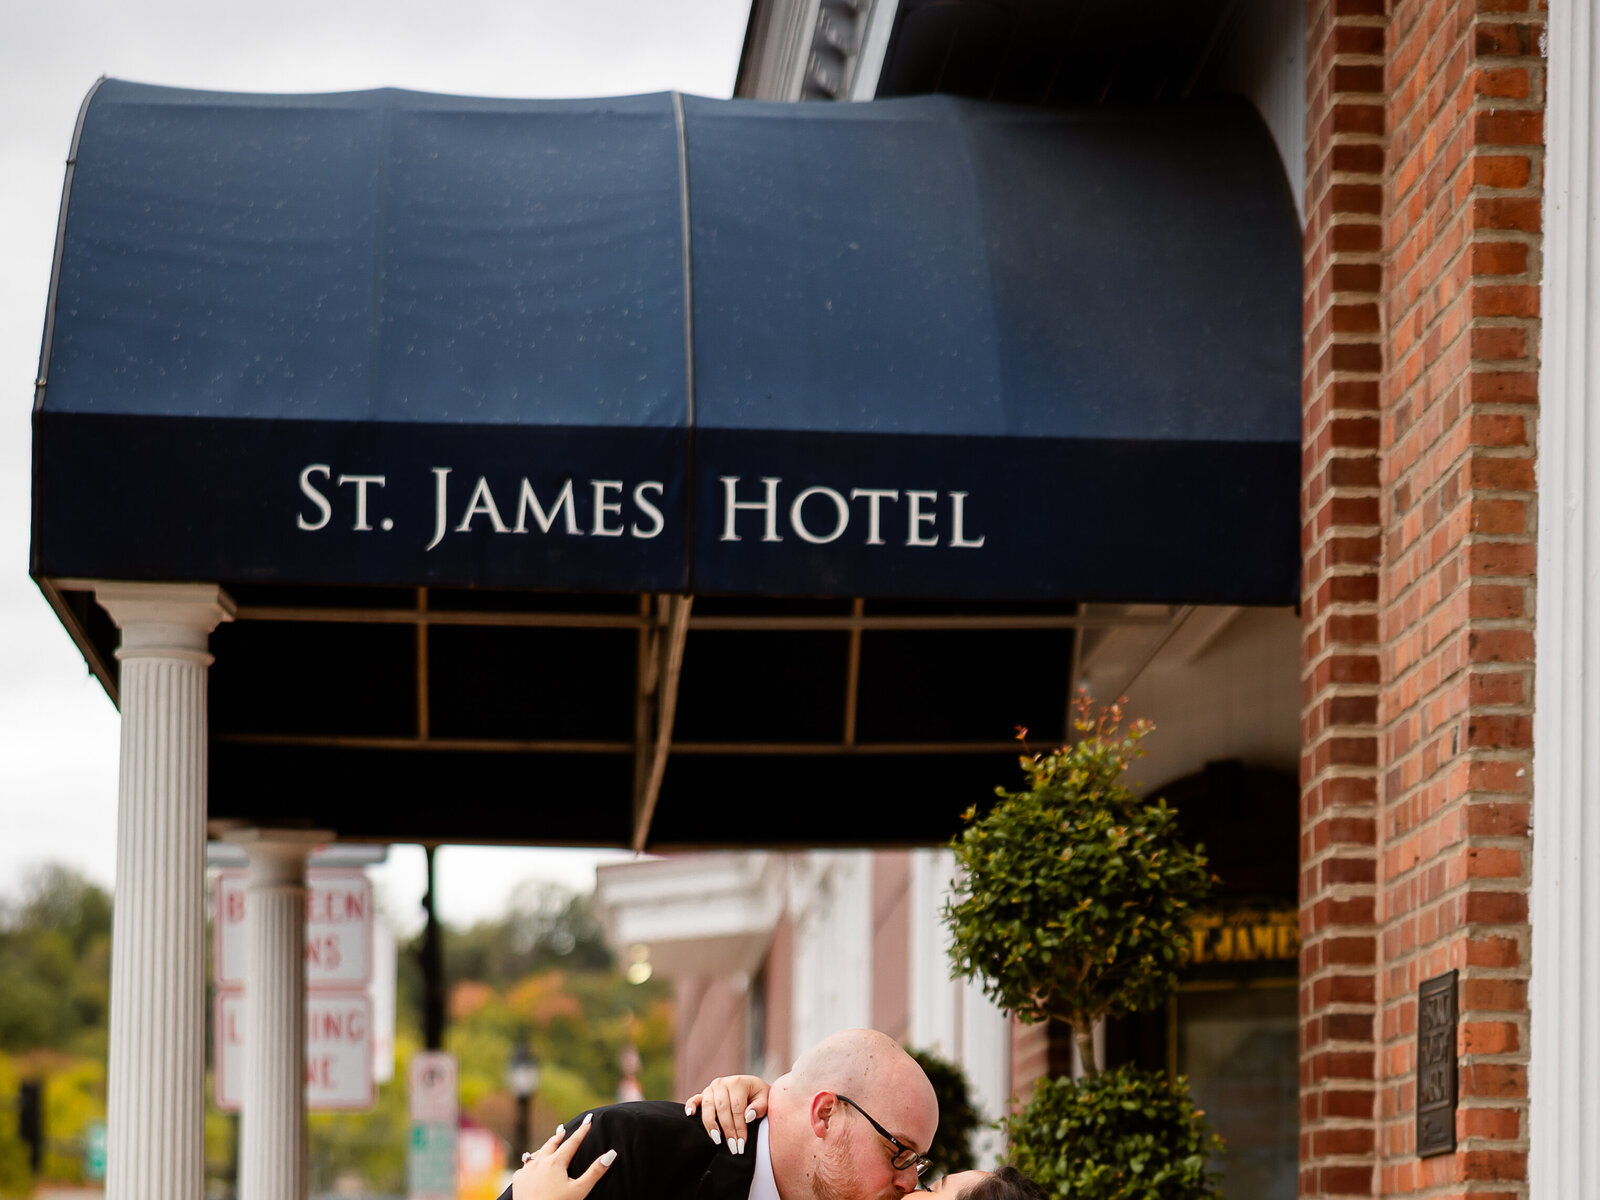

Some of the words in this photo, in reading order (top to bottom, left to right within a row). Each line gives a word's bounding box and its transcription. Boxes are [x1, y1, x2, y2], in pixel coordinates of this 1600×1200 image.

[297, 464, 394, 531] ST.
[425, 466, 665, 551] JAMES
[719, 475, 985, 548] HOTEL
[228, 1010, 366, 1045] LING
